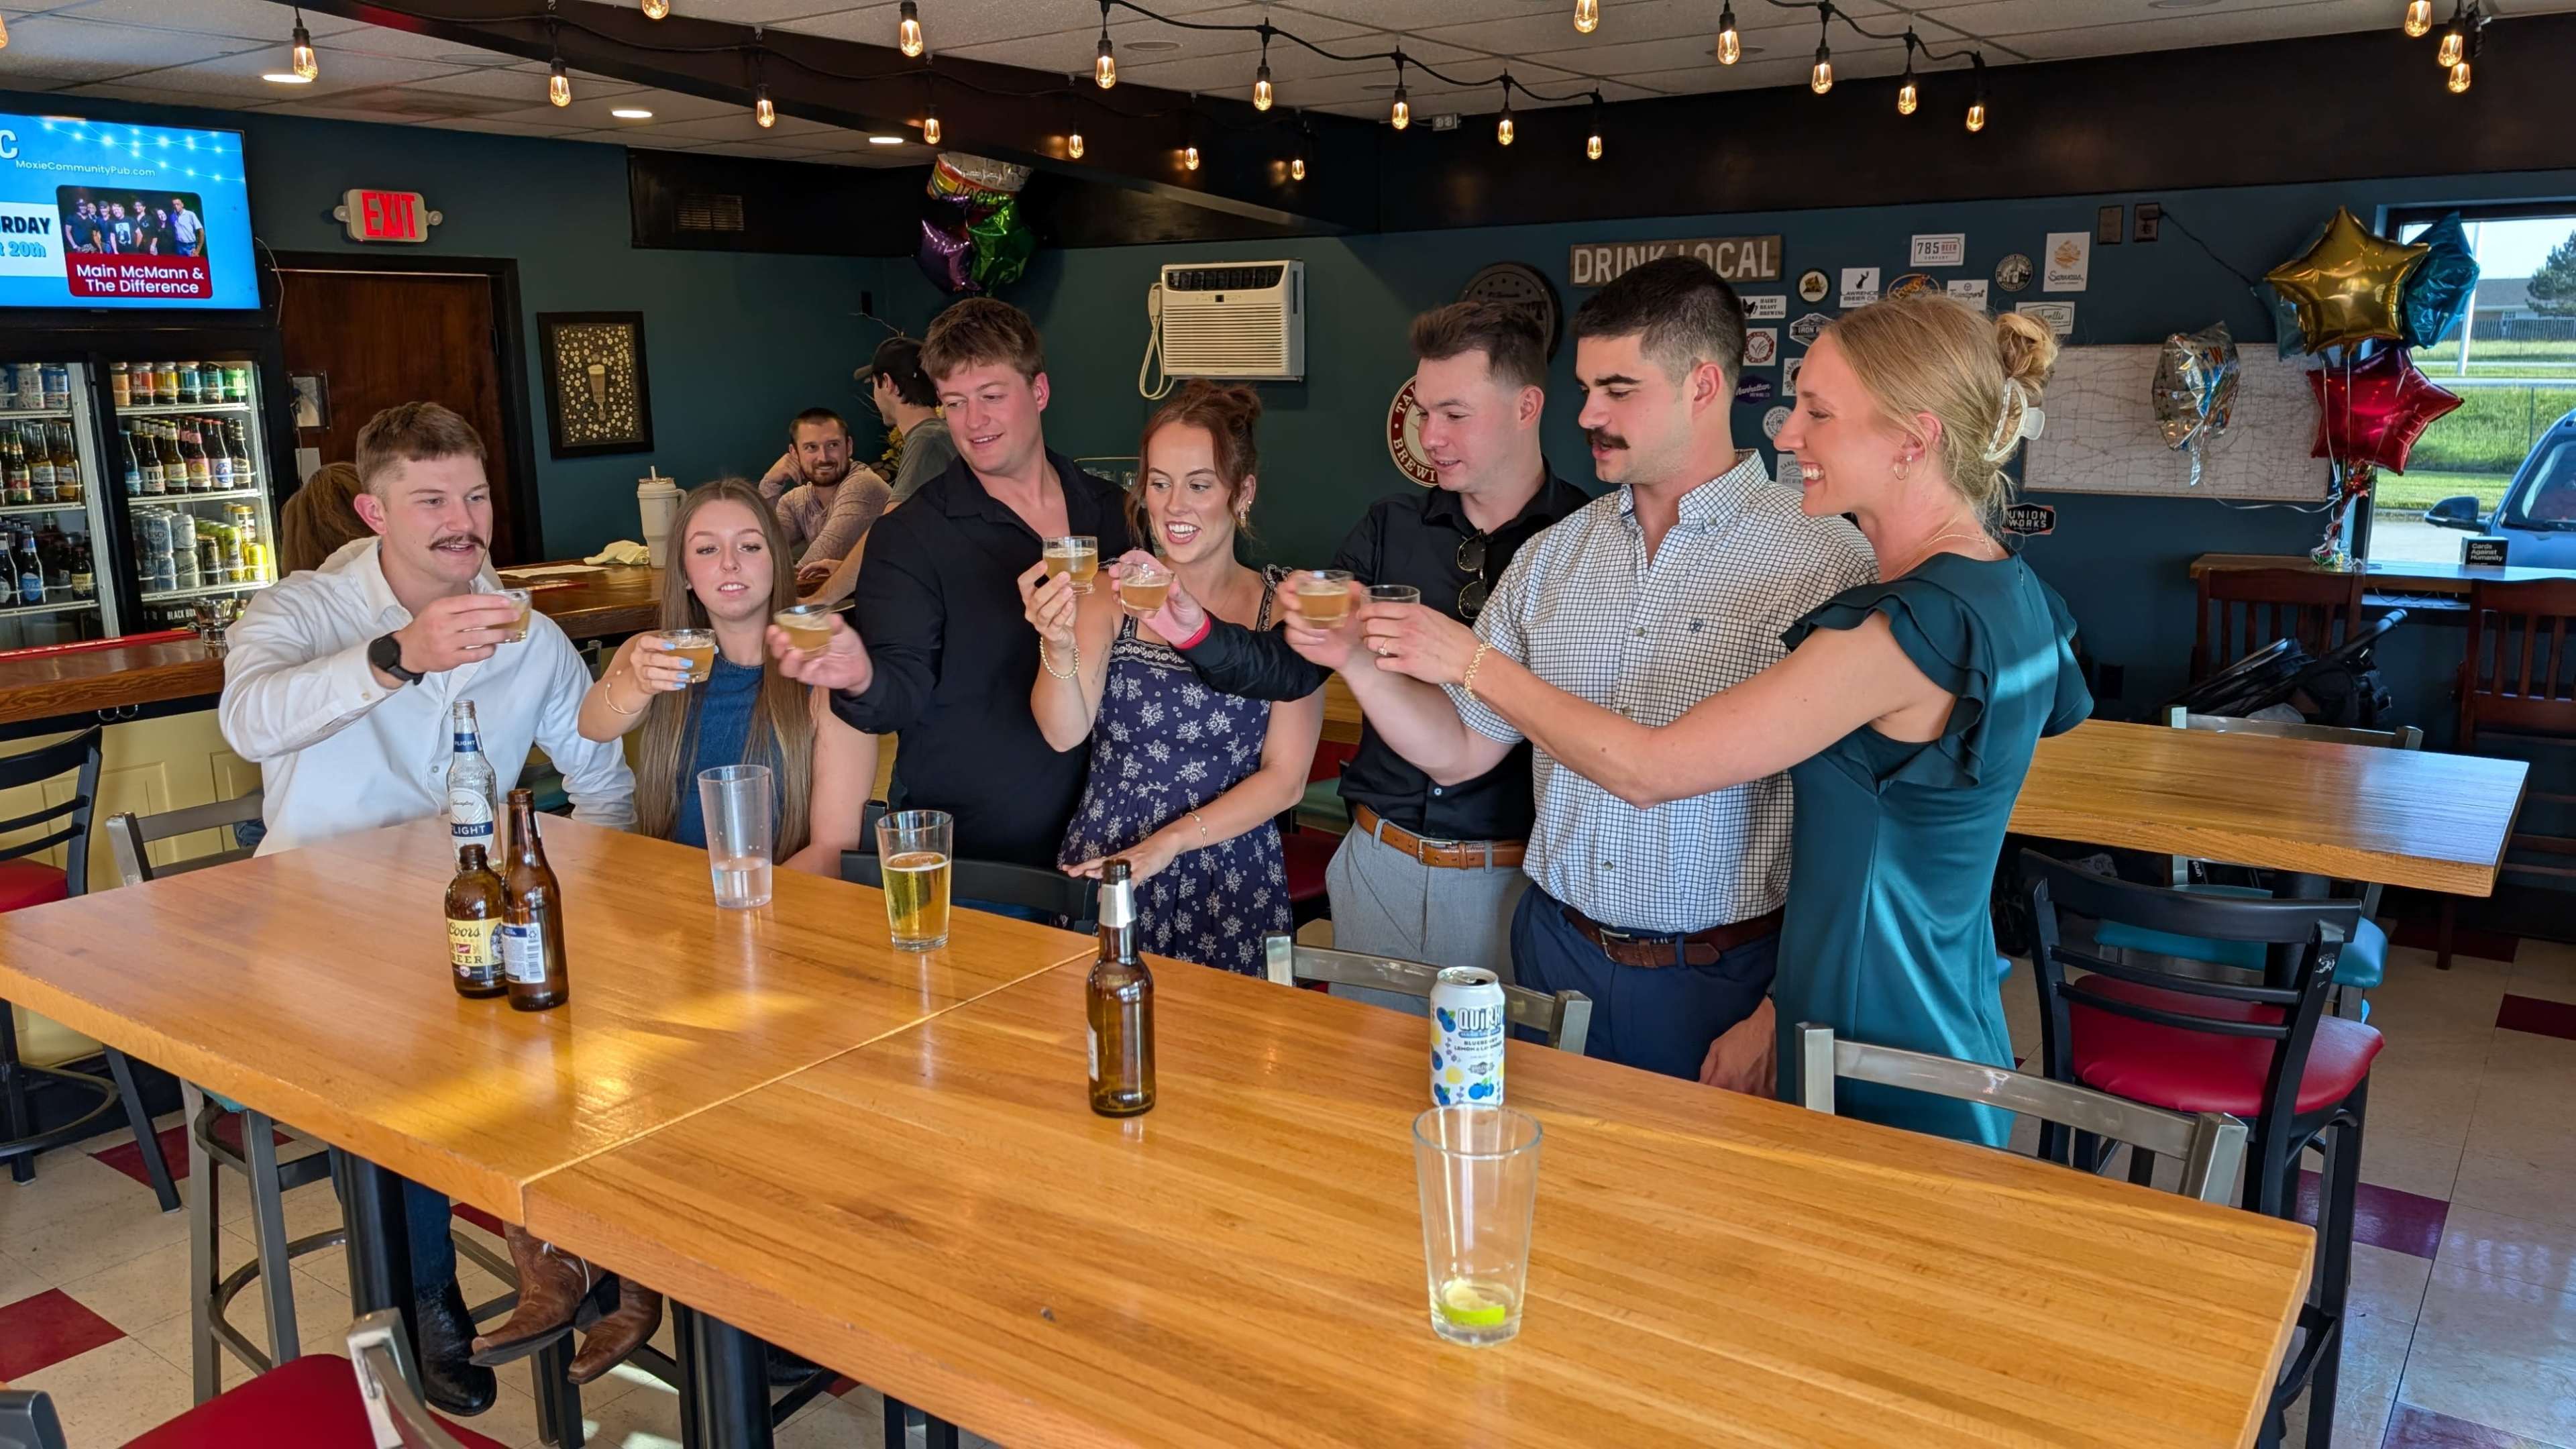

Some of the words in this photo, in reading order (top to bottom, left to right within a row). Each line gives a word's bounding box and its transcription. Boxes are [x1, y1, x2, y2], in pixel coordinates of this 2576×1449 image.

[16, 160, 156, 176] MoxieCommunityPub.com
[362, 192, 416, 237] EXIT
[0, 216, 50, 234] RDAY
[9, 241, 46, 258] 20th
[1918, 242, 1939, 254] 785
[1941, 244, 1957, 252] BEER
[76, 264, 117, 278] Main
[121, 266, 188, 279] McMann
[193, 267, 204, 279] &
[85, 279, 115, 292] The
[119, 280, 199, 293] Difference
[1393, 437, 1437, 482] BREWI
[2008, 511, 2047, 520] UNION
[2008, 519, 2047, 528] WORKS
[167, 610, 184, 620] BLACK
[448, 922, 481, 937] Coors
